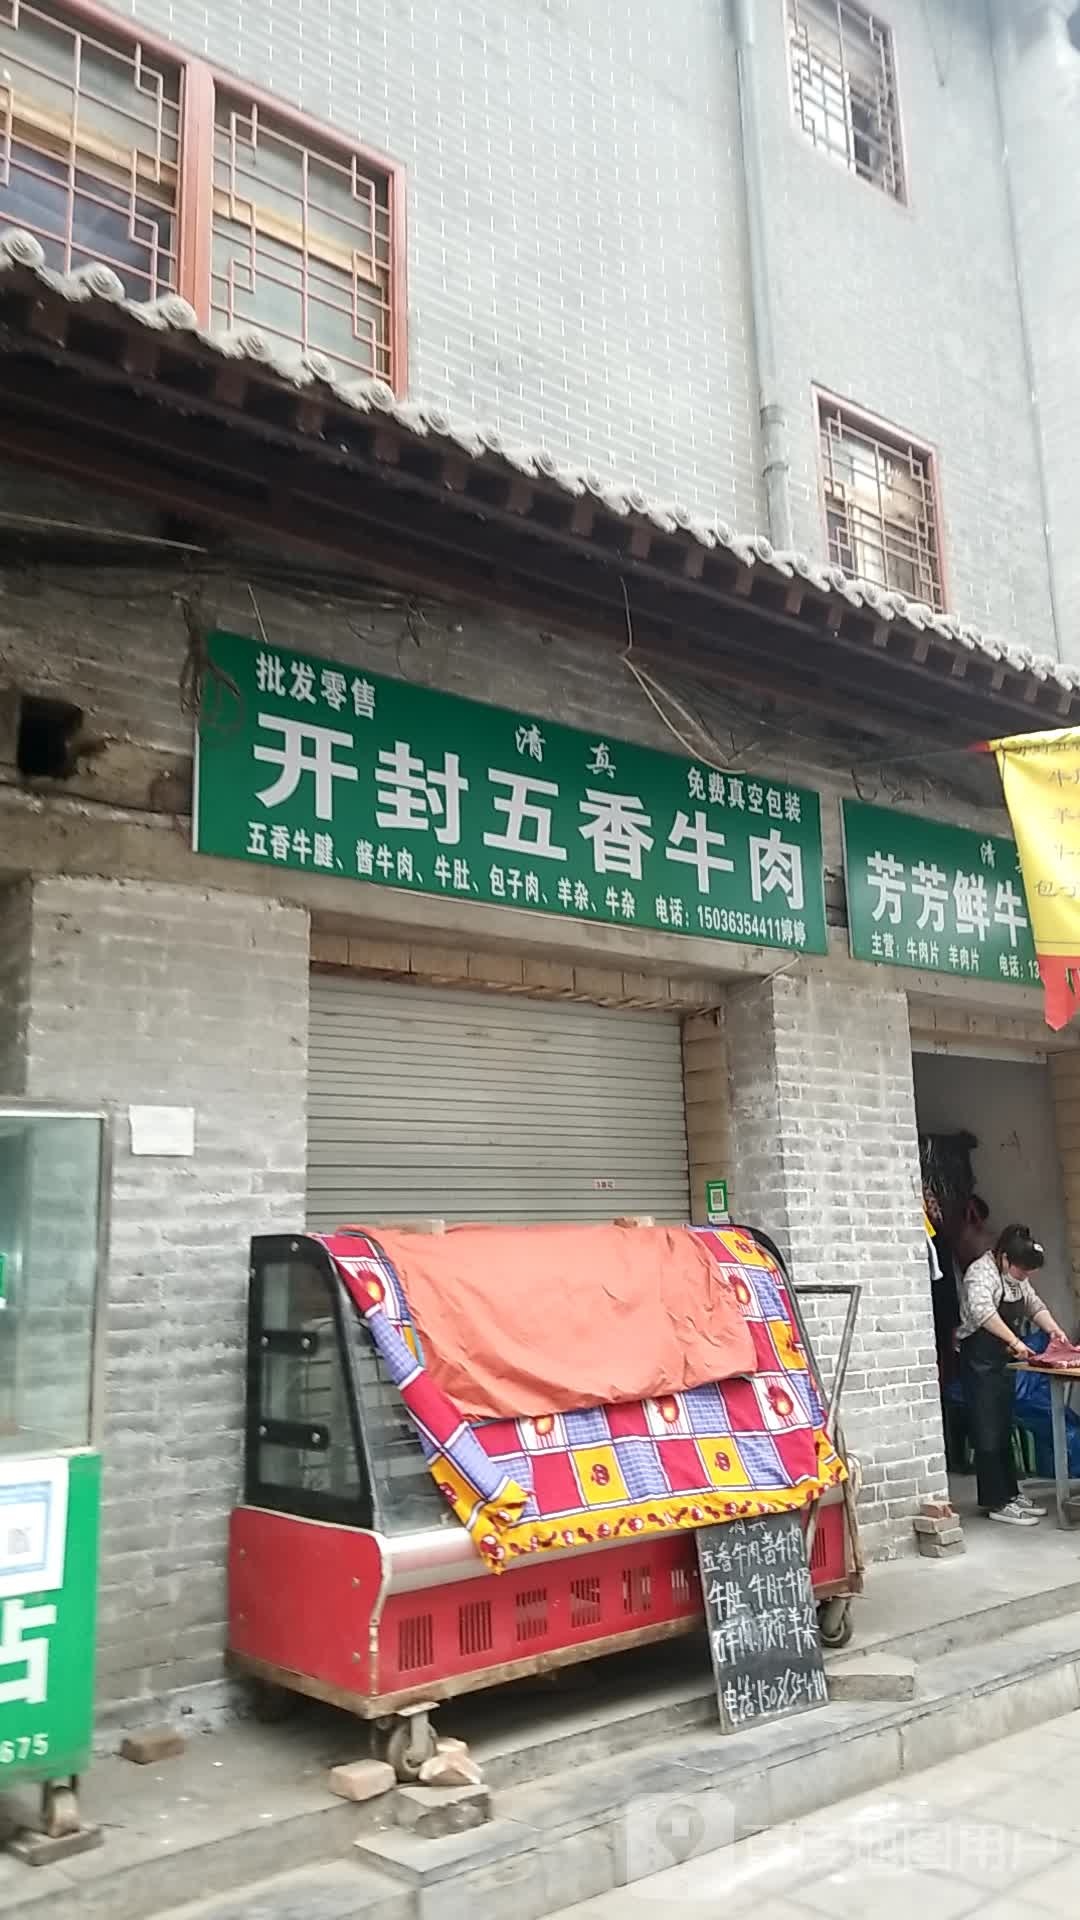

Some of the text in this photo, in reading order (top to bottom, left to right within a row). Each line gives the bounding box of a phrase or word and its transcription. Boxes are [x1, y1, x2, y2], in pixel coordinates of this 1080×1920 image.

[256, 651, 376, 720] 批发零售
[253, 712, 805, 910] 开封五香牛肉
[687, 766, 802, 824] 免费真空包装
[866, 850, 1028, 947] 芳芳鲜牛
